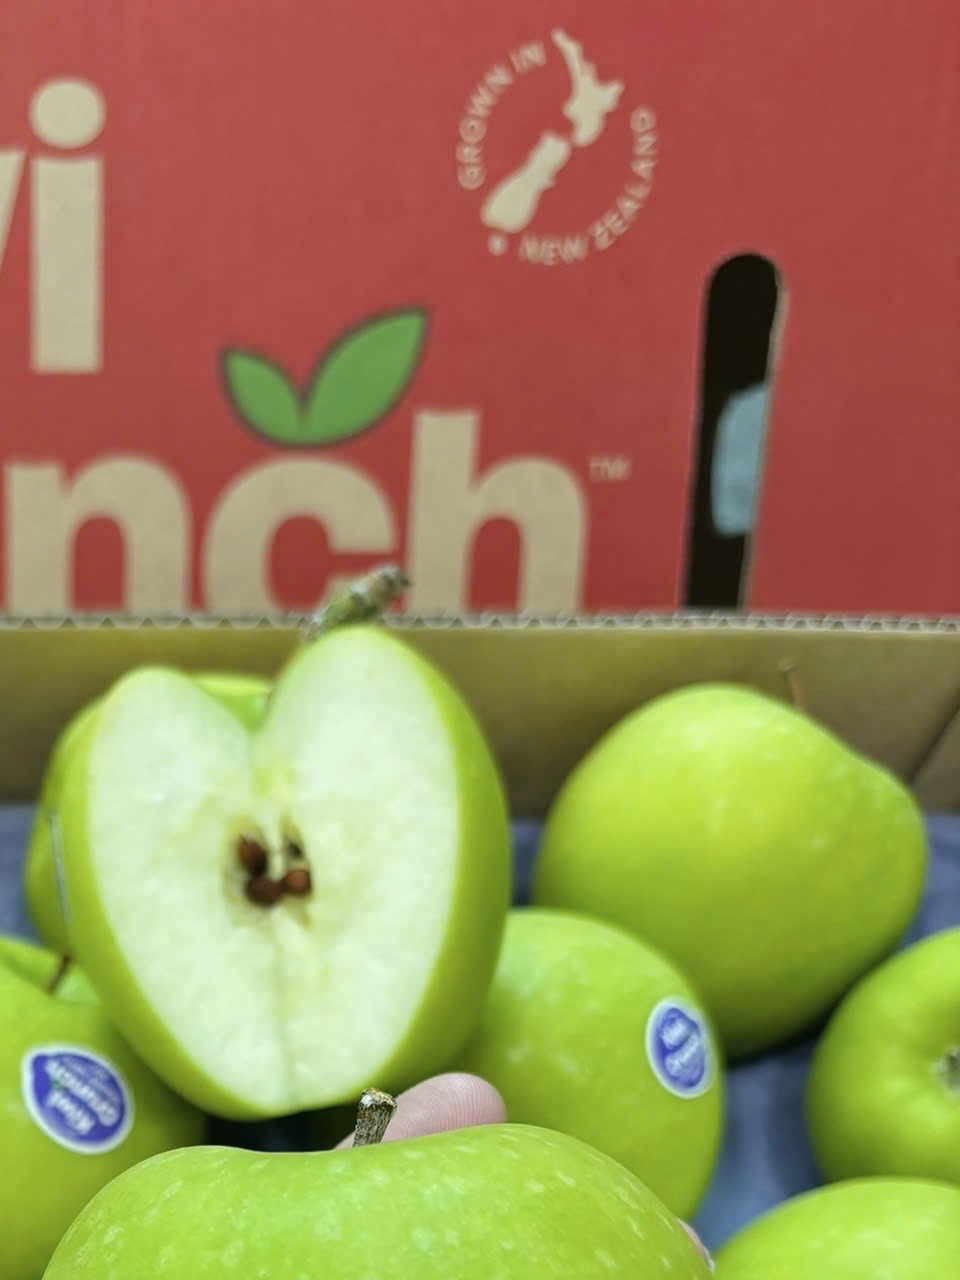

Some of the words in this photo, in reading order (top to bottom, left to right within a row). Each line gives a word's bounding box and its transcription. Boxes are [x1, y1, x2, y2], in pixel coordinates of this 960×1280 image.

[456, 62, 514, 190] GROWN
[509, 42, 547, 74] IN
[517, 233, 589, 266] NEW
[587, 106, 658, 250] ZEALAND
